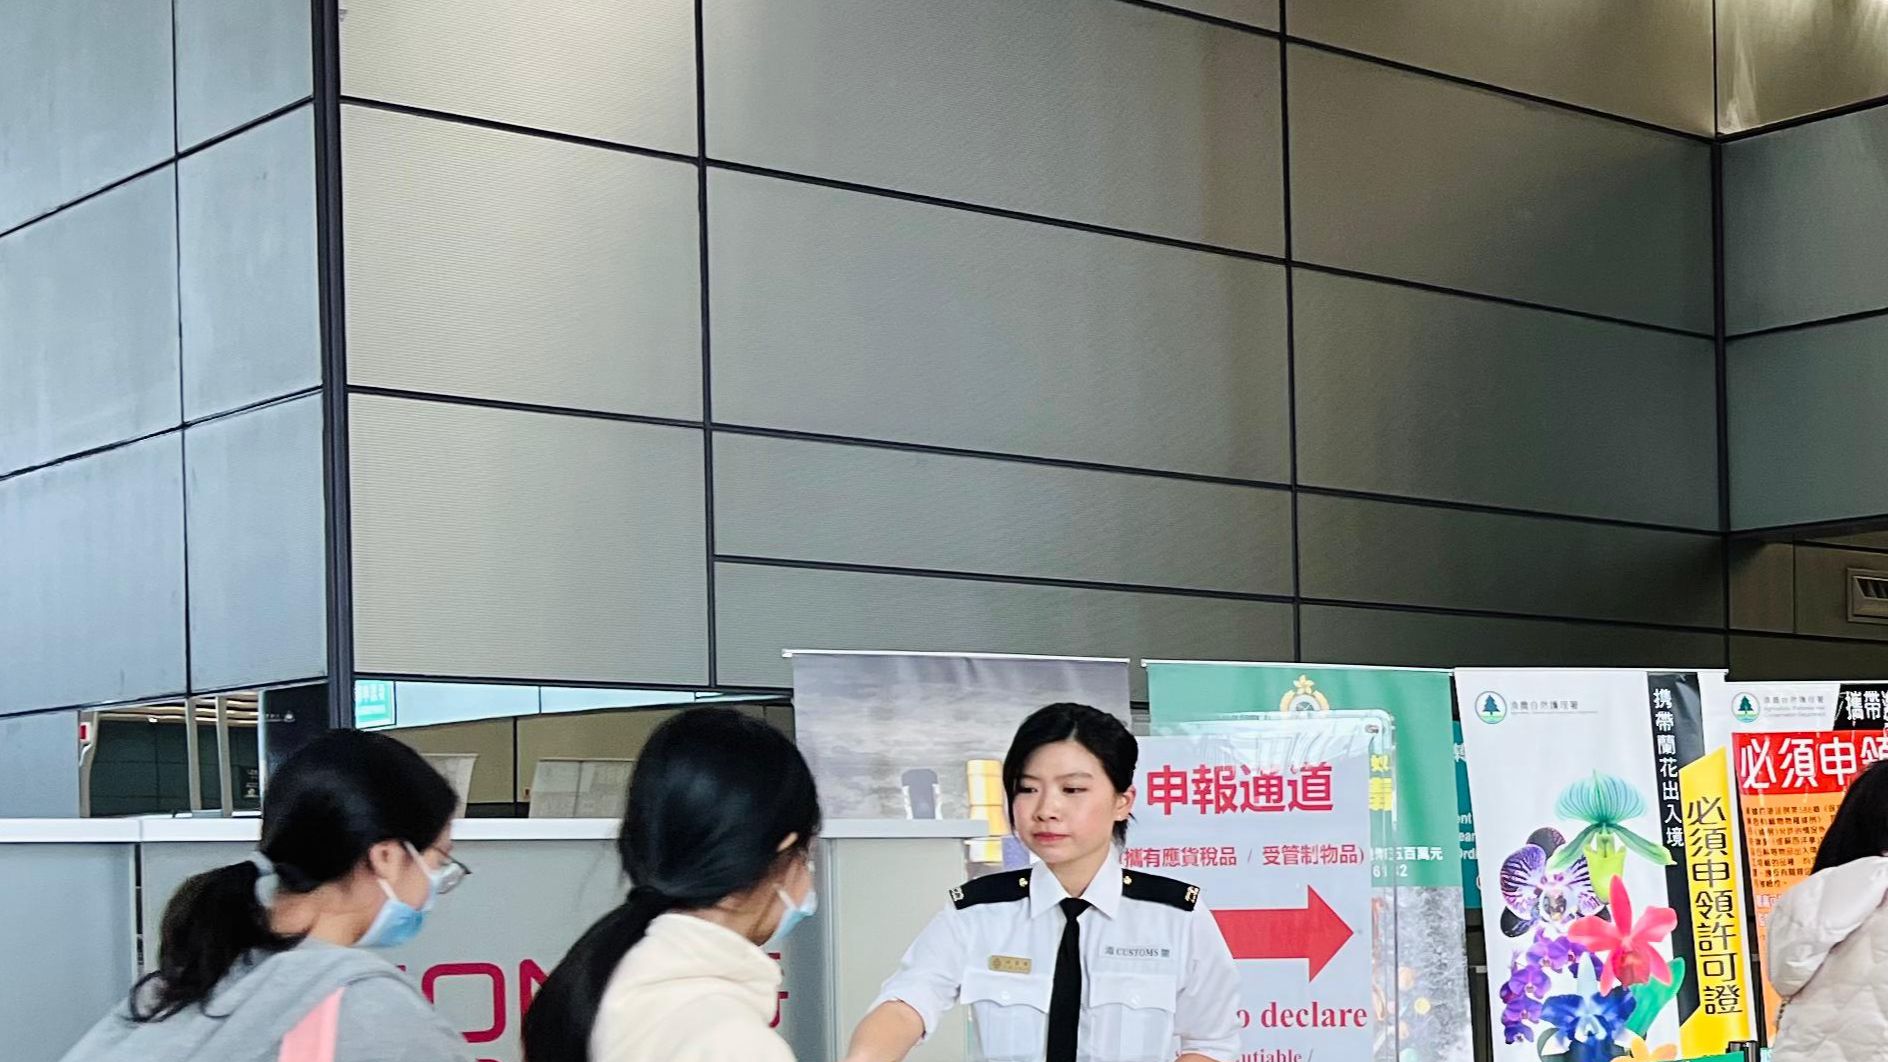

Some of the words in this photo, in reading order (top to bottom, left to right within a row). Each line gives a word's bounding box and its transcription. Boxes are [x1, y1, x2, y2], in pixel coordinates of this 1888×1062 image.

[1146, 761, 1334, 815] 申報通道
[1262, 844, 1365, 866] 受管制物品)
[1686, 796, 1743, 1015] 必須申領許可證
[1260, 1002, 1368, 1028] declare
